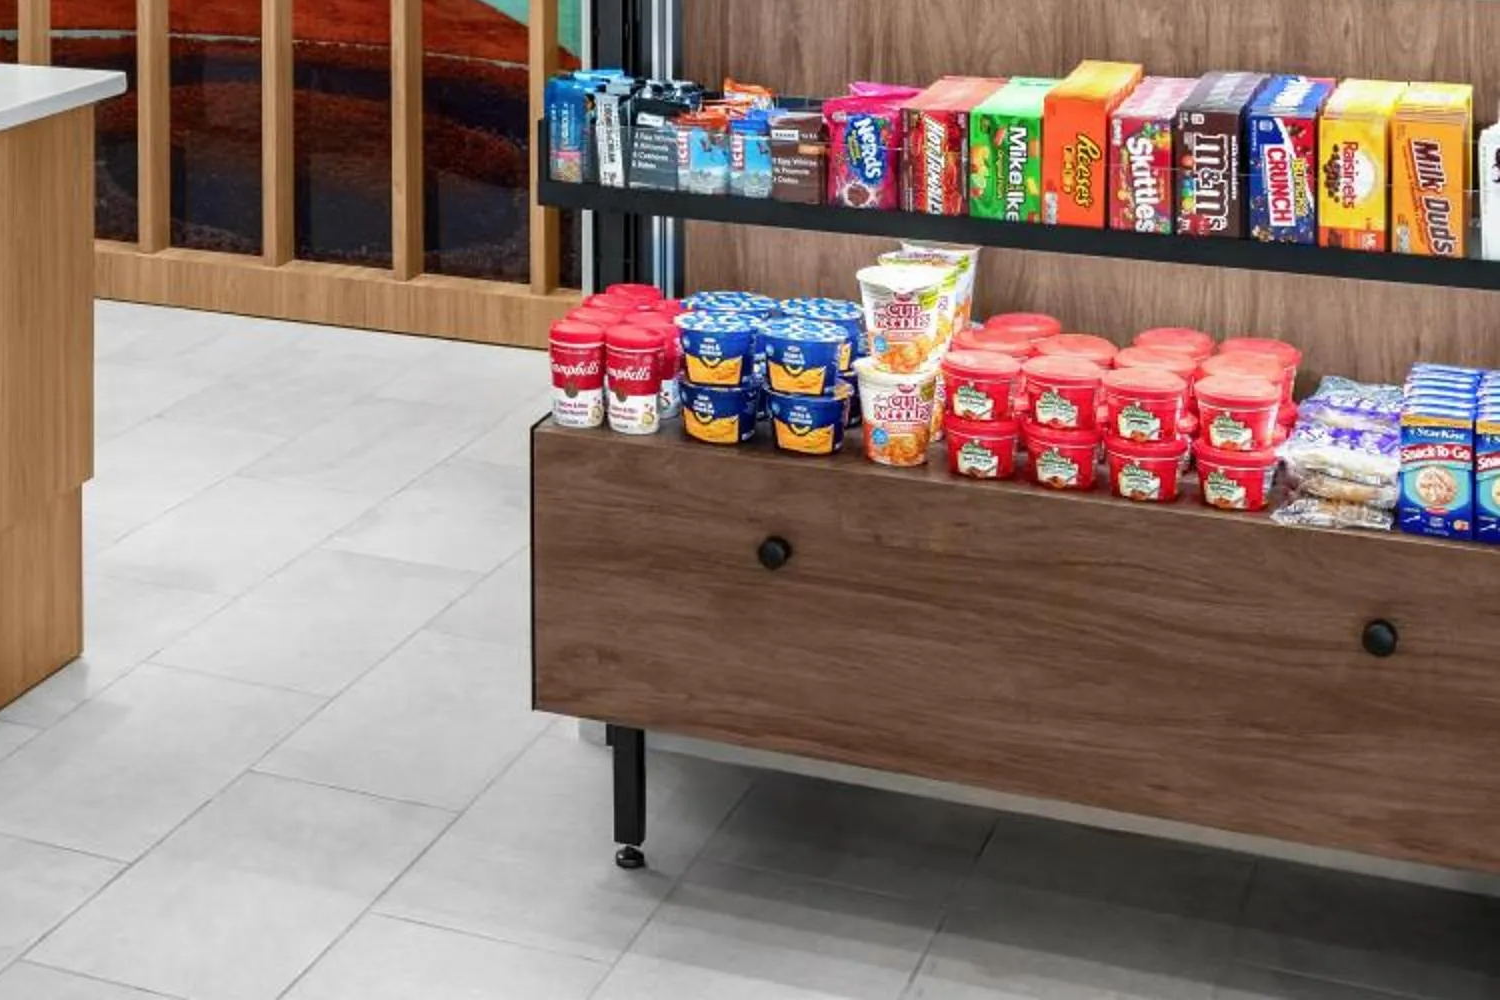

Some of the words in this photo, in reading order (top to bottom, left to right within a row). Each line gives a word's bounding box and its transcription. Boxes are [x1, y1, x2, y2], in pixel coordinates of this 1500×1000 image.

[853, 117, 882, 179] Nerds
[1009, 126, 1028, 185] Mike
[1342, 141, 1360, 209] Raisinets
[1412, 140, 1446, 191] Milk
[1126, 136, 1158, 233] Skittles
[1266, 147, 1293, 222] CRUNCH
[1423, 196, 1457, 254] Duds
[1401, 445, 1436, 462] Snack
